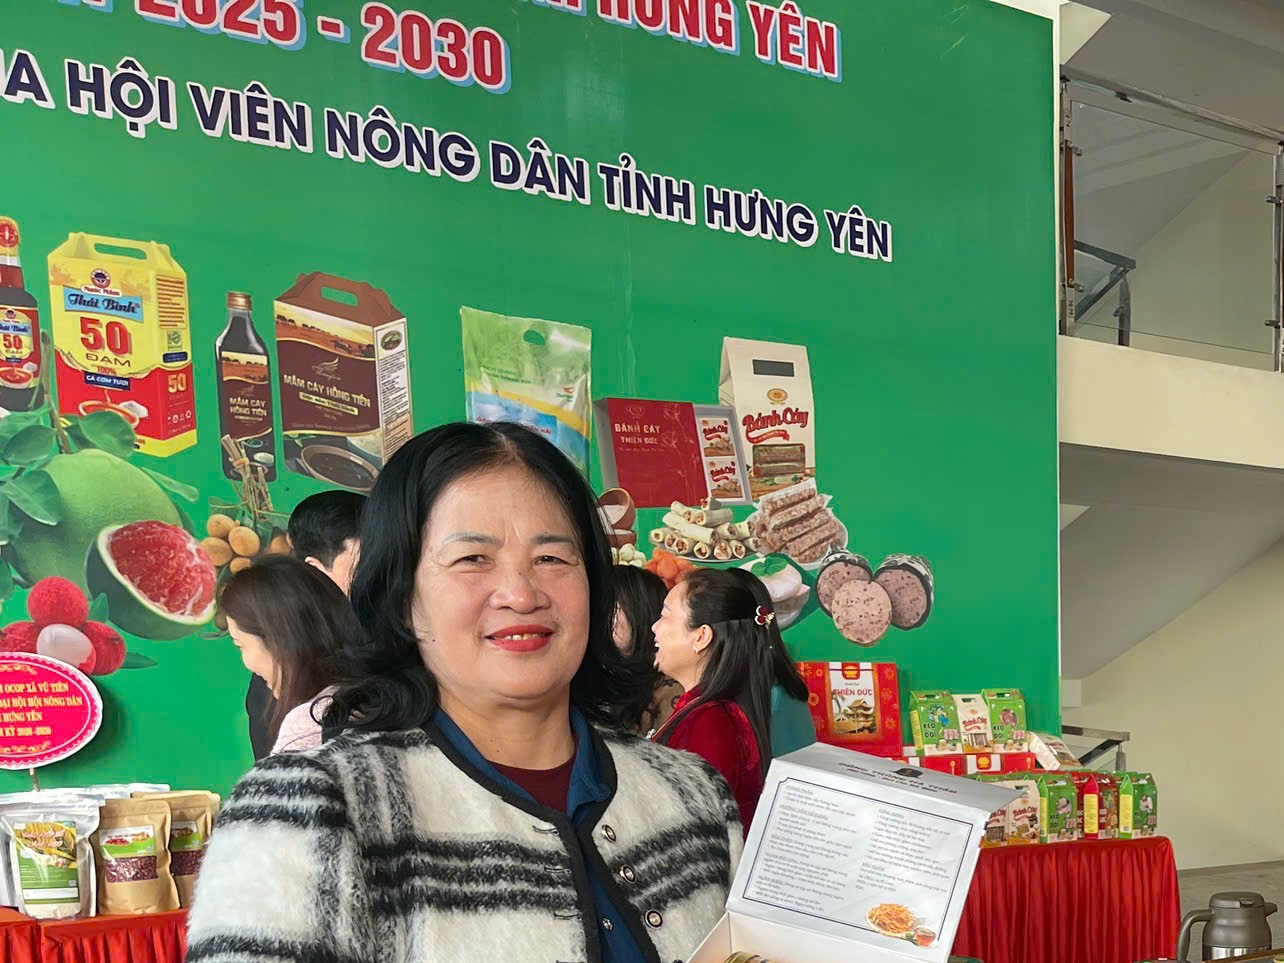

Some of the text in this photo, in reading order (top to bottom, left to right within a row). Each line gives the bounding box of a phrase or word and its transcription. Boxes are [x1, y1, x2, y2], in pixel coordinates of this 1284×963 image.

[361, 2, 508, 89] 2030
[747, 0, 840, 80] YÊN
[0, 49, 892, 262] A HỘI VIÊN NÔNG DÂN TỈNH HƯNG YÊN
[3, 334, 22, 350] 50
[79, 317, 132, 355] 50
[857, 686, 873, 697] ĐỨC
